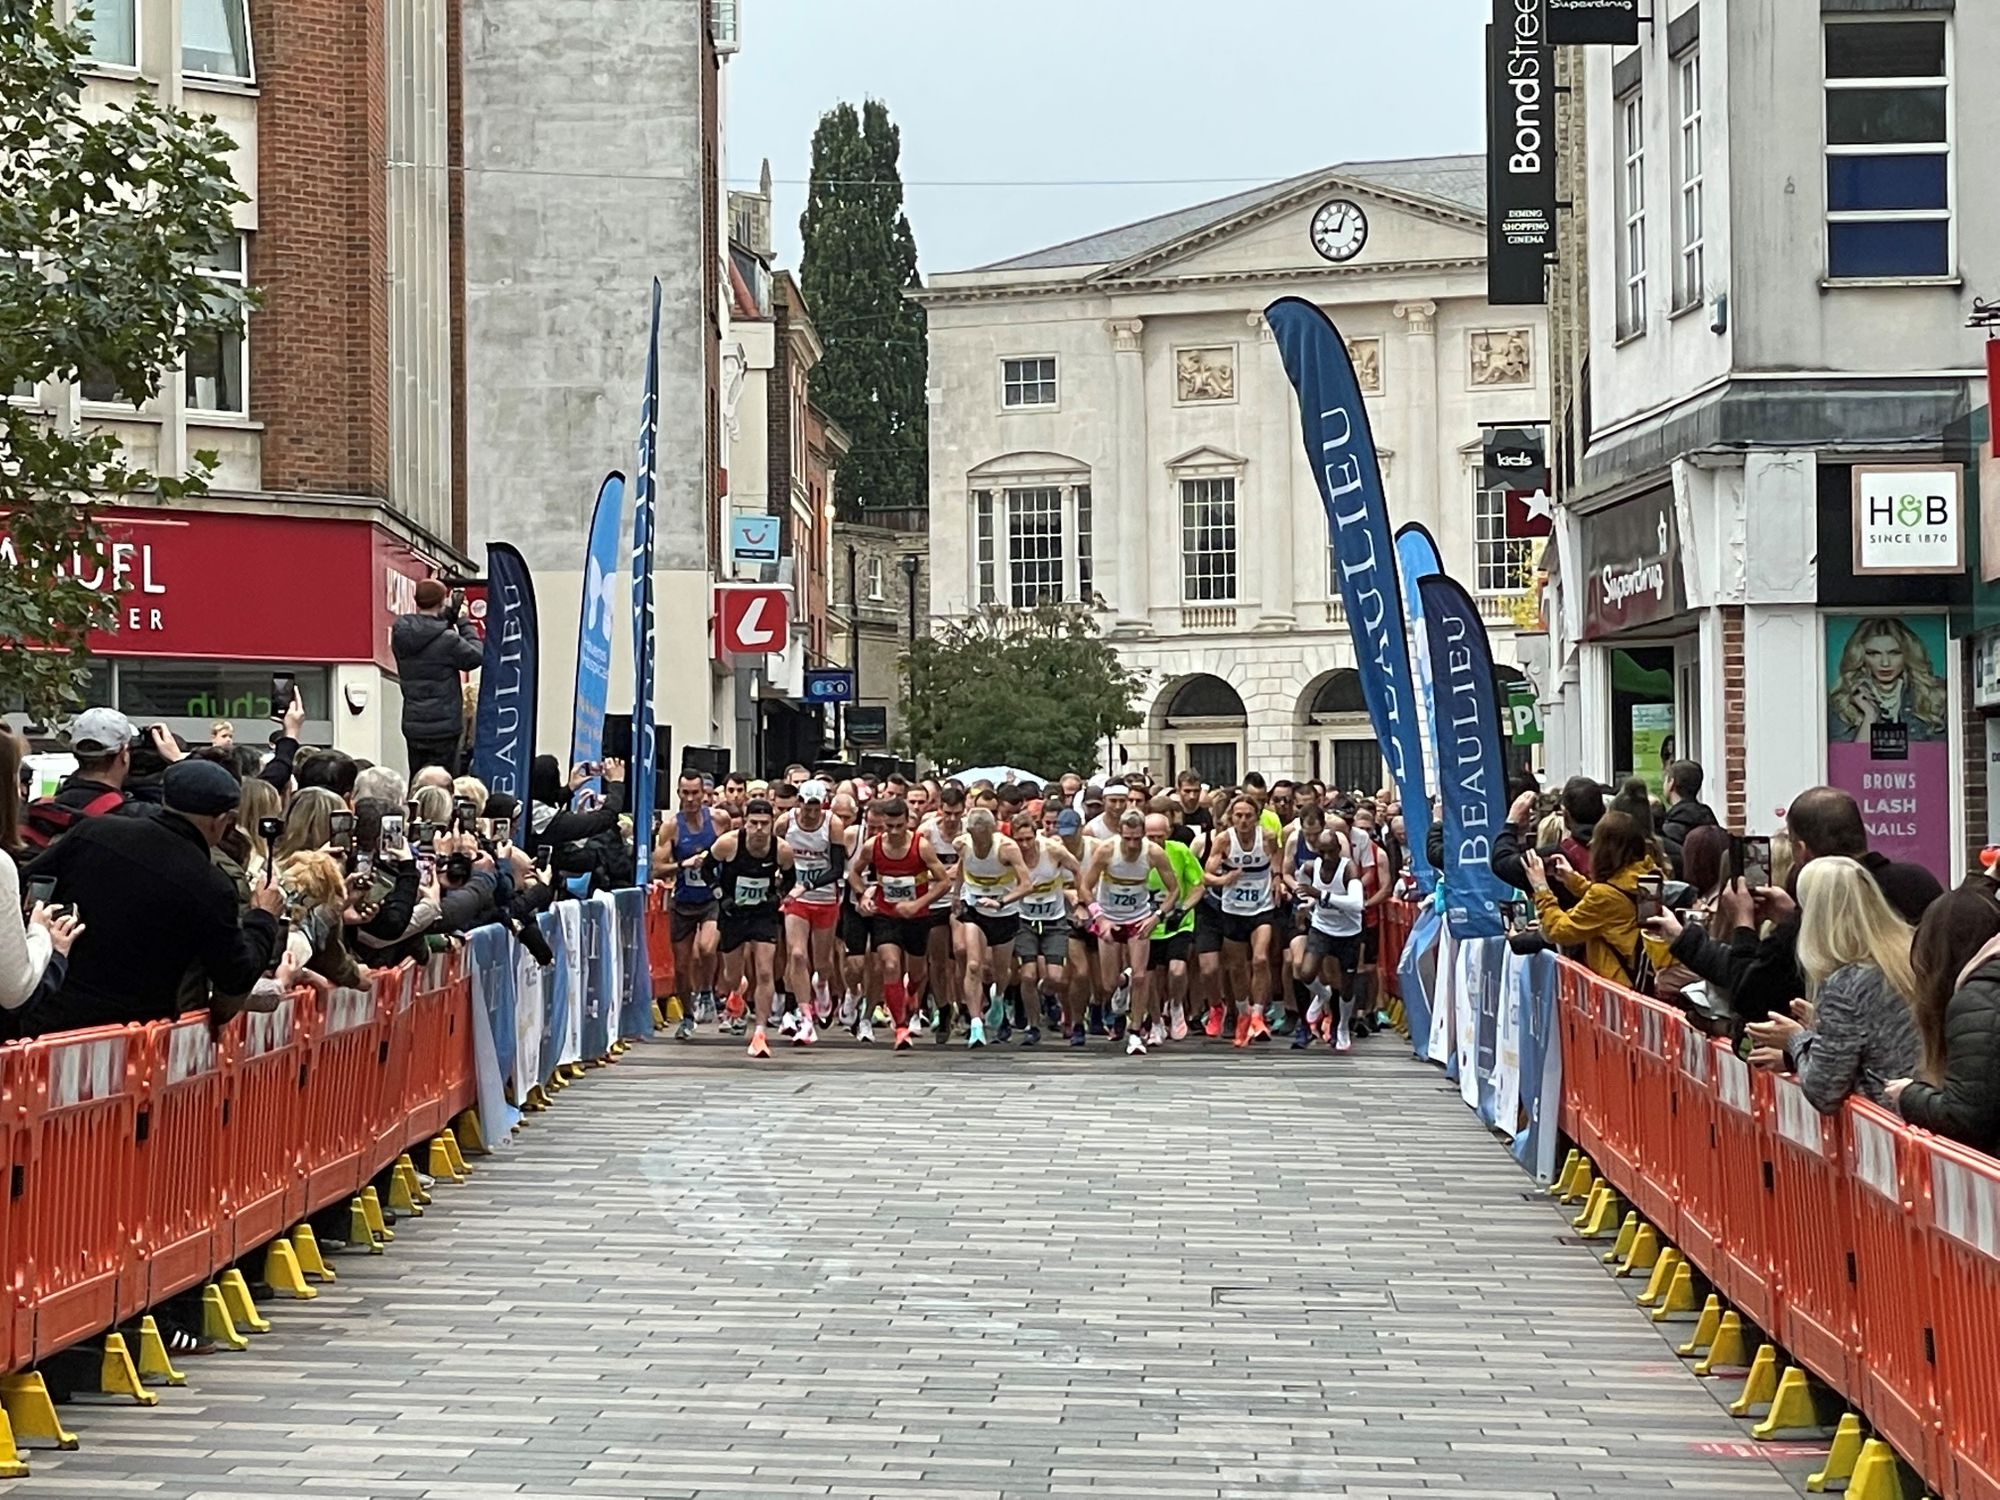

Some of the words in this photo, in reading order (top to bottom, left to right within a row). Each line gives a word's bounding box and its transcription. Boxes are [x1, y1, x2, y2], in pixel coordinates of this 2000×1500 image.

[1501, 221, 1550, 231] SHOPPING
[1507, 235, 1545, 245] CINEMA
[1496, 451, 1533, 467] kids
[1869, 494, 1948, 527] H&B
[1869, 533, 1912, 544] SINCE
[1918, 533, 1948, 544] 1870
[1602, 557, 1665, 610] Superdrug
[491, 584, 523, 803] EAULIEU
[1442, 614, 1491, 868] BEAULIEU
[1863, 773, 1917, 790] BROWS
[1863, 799, 1917, 814] LASH
[1863, 822, 1917, 836] NAILS
[740, 886, 763, 899] 701
[1236, 888, 1259, 902] 218
[1114, 894, 1137, 906] 726
[1029, 903, 1051, 914] 717
